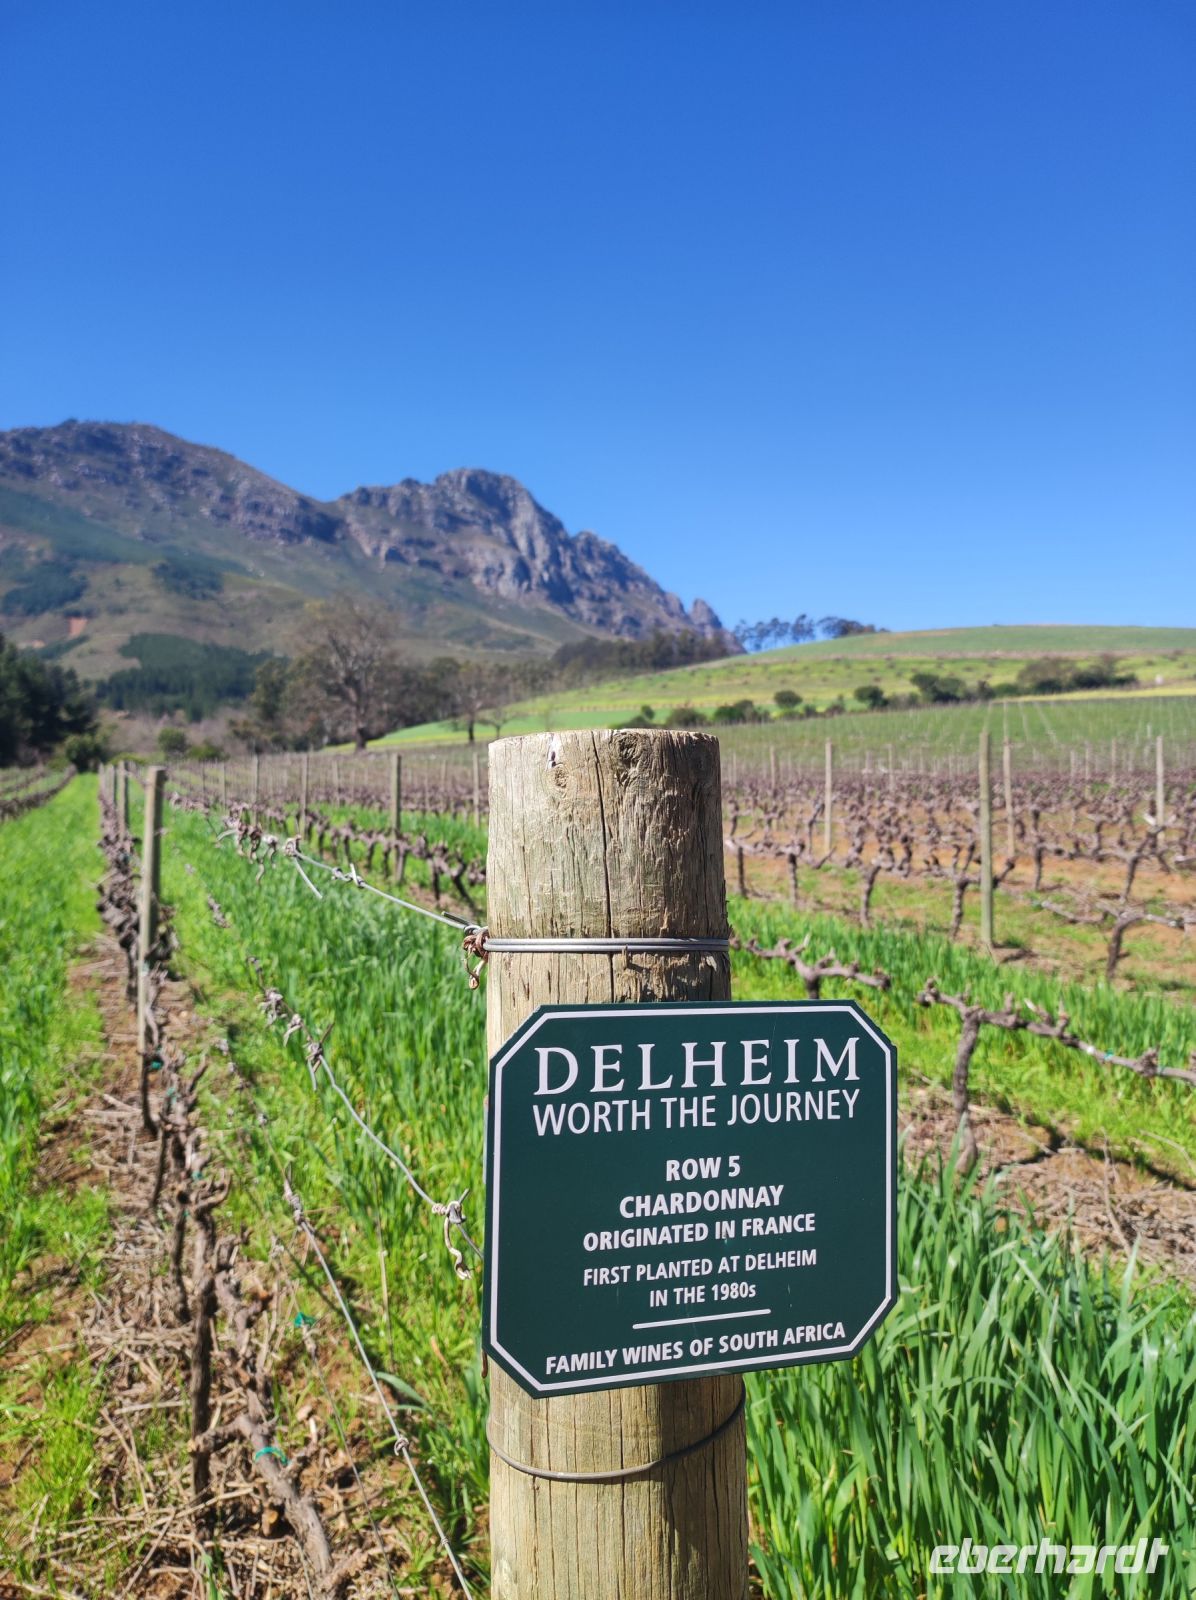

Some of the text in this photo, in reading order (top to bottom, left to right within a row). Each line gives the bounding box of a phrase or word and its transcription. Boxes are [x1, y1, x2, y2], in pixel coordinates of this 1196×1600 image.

[534, 1037, 860, 1095] DELHEIM
[533, 1089, 859, 1136] WORTH THE JOURNEY
[666, 1156, 740, 1181] ROW 5
[620, 1185, 784, 1218] CHARDONNAY
[584, 1213, 815, 1251] ORIGINATED IN FRANCE
[584, 1249, 816, 1286] FIRST PLANTED AT DELHEIM
[650, 1282, 756, 1307] IN THE 1980s
[546, 1322, 845, 1374] FAMILY WINES OF SOUTH AFRICA
